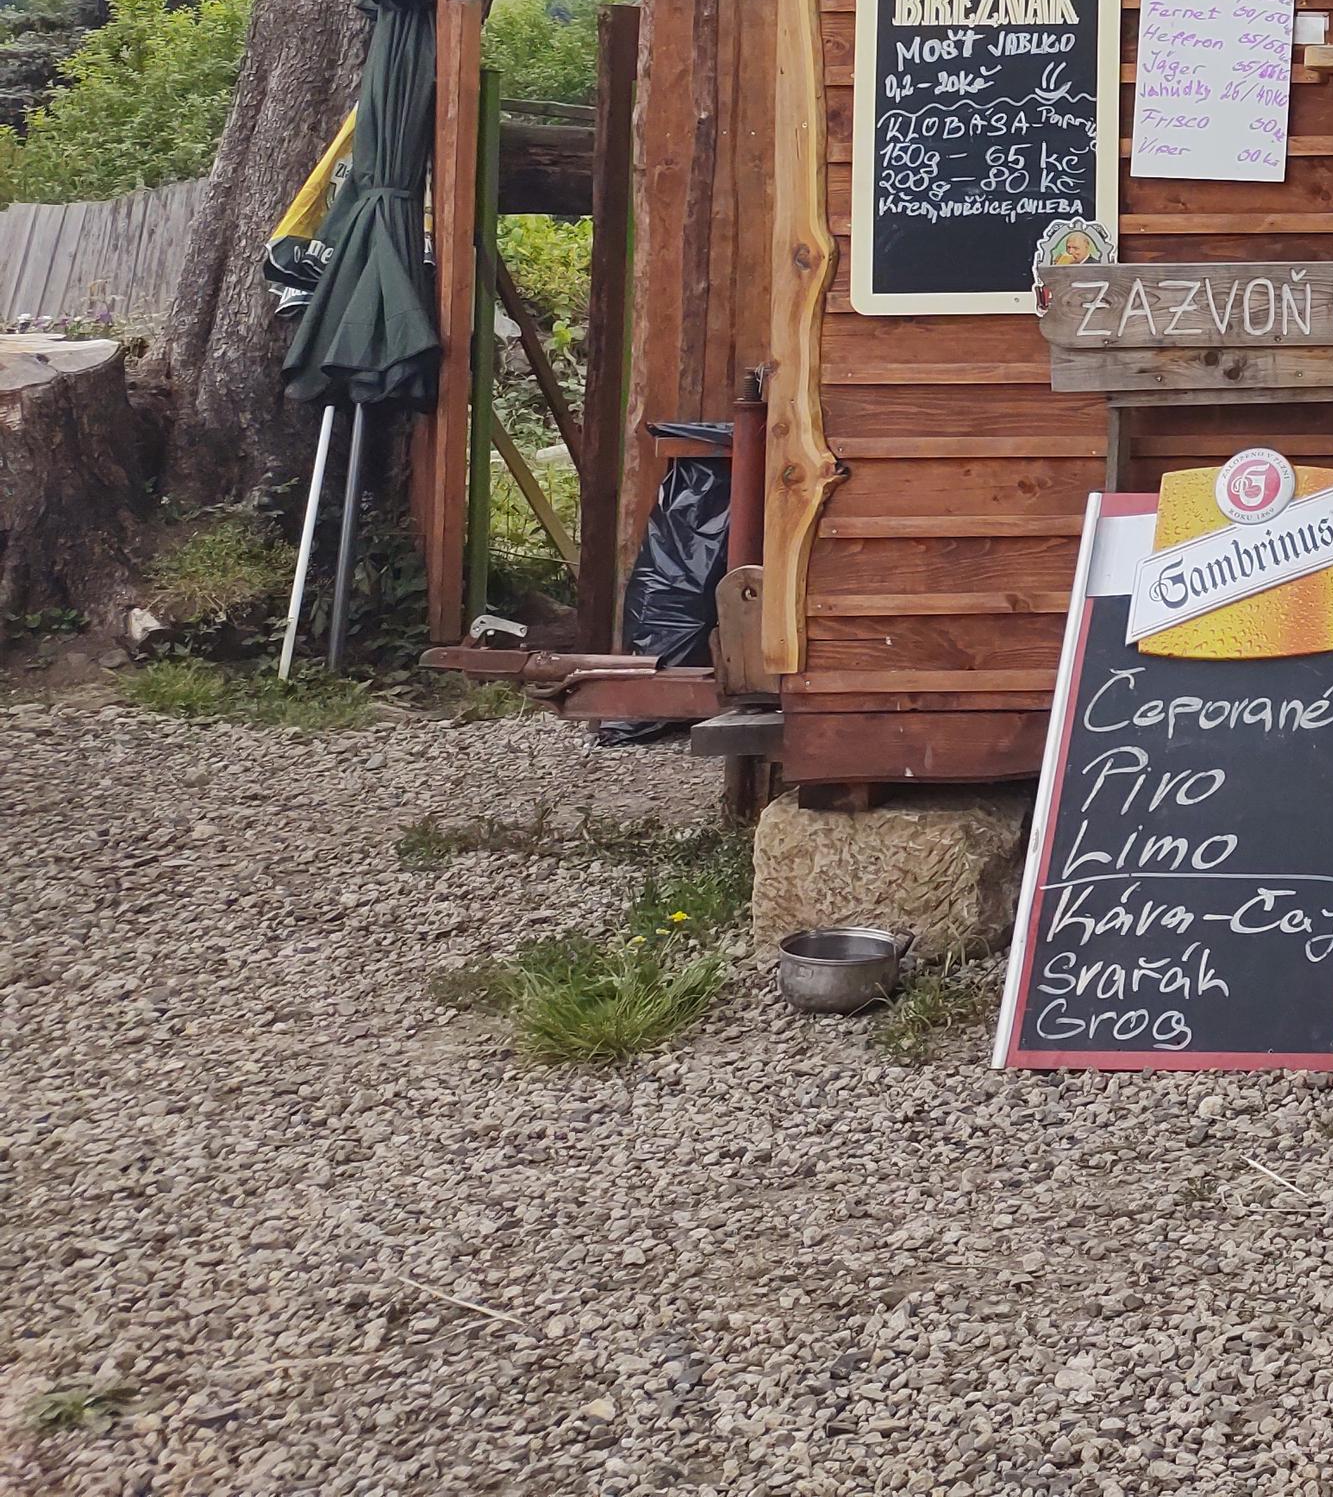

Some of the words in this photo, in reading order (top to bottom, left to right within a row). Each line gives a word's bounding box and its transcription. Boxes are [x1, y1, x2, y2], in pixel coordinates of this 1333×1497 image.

[1147, 1, 1221, 20] Fernet
[988, 31, 1075, 56] JABLKO
[880, 142, 941, 177] 150g
[984, 143, 1033, 169] 65
[980, 166, 1029, 194] 80
[1071, 267, 1312, 337] ZAZVOŇ
[1081, 745, 1226, 816] Pivo
[1061, 819, 1238, 880] Limo
[1037, 942, 1230, 1000] Svařák
[1036, 999, 1193, 1051] Grog
